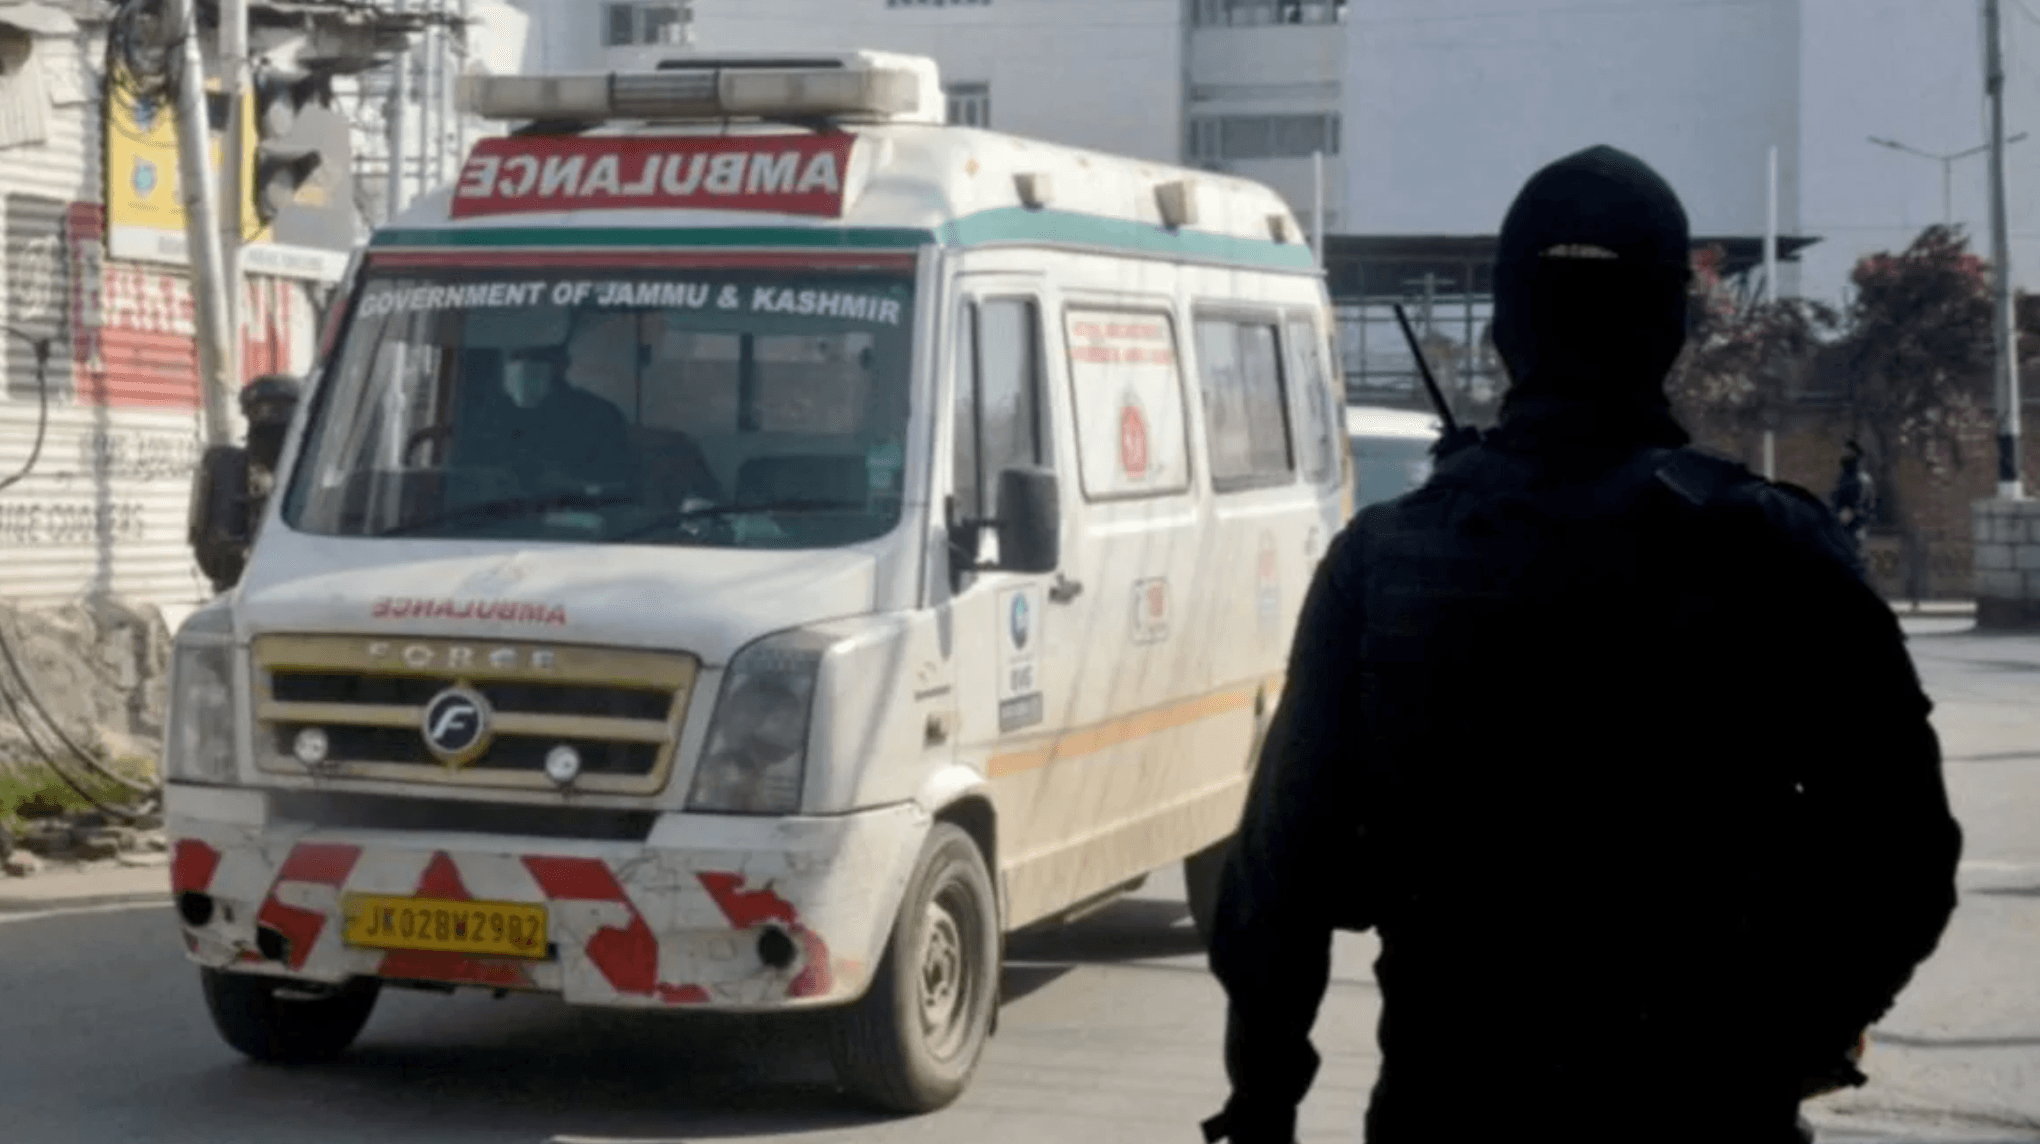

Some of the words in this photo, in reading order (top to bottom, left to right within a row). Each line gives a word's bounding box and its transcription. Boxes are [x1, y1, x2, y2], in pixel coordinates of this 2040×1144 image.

[358, 281, 547, 317] GOVERNMENT
[552, 282, 591, 306] OF
[597, 281, 710, 308] JAMMU
[716, 284, 740, 309] &
[752, 285, 901, 325] KASHMIR
[368, 641, 555, 670] FORCE
